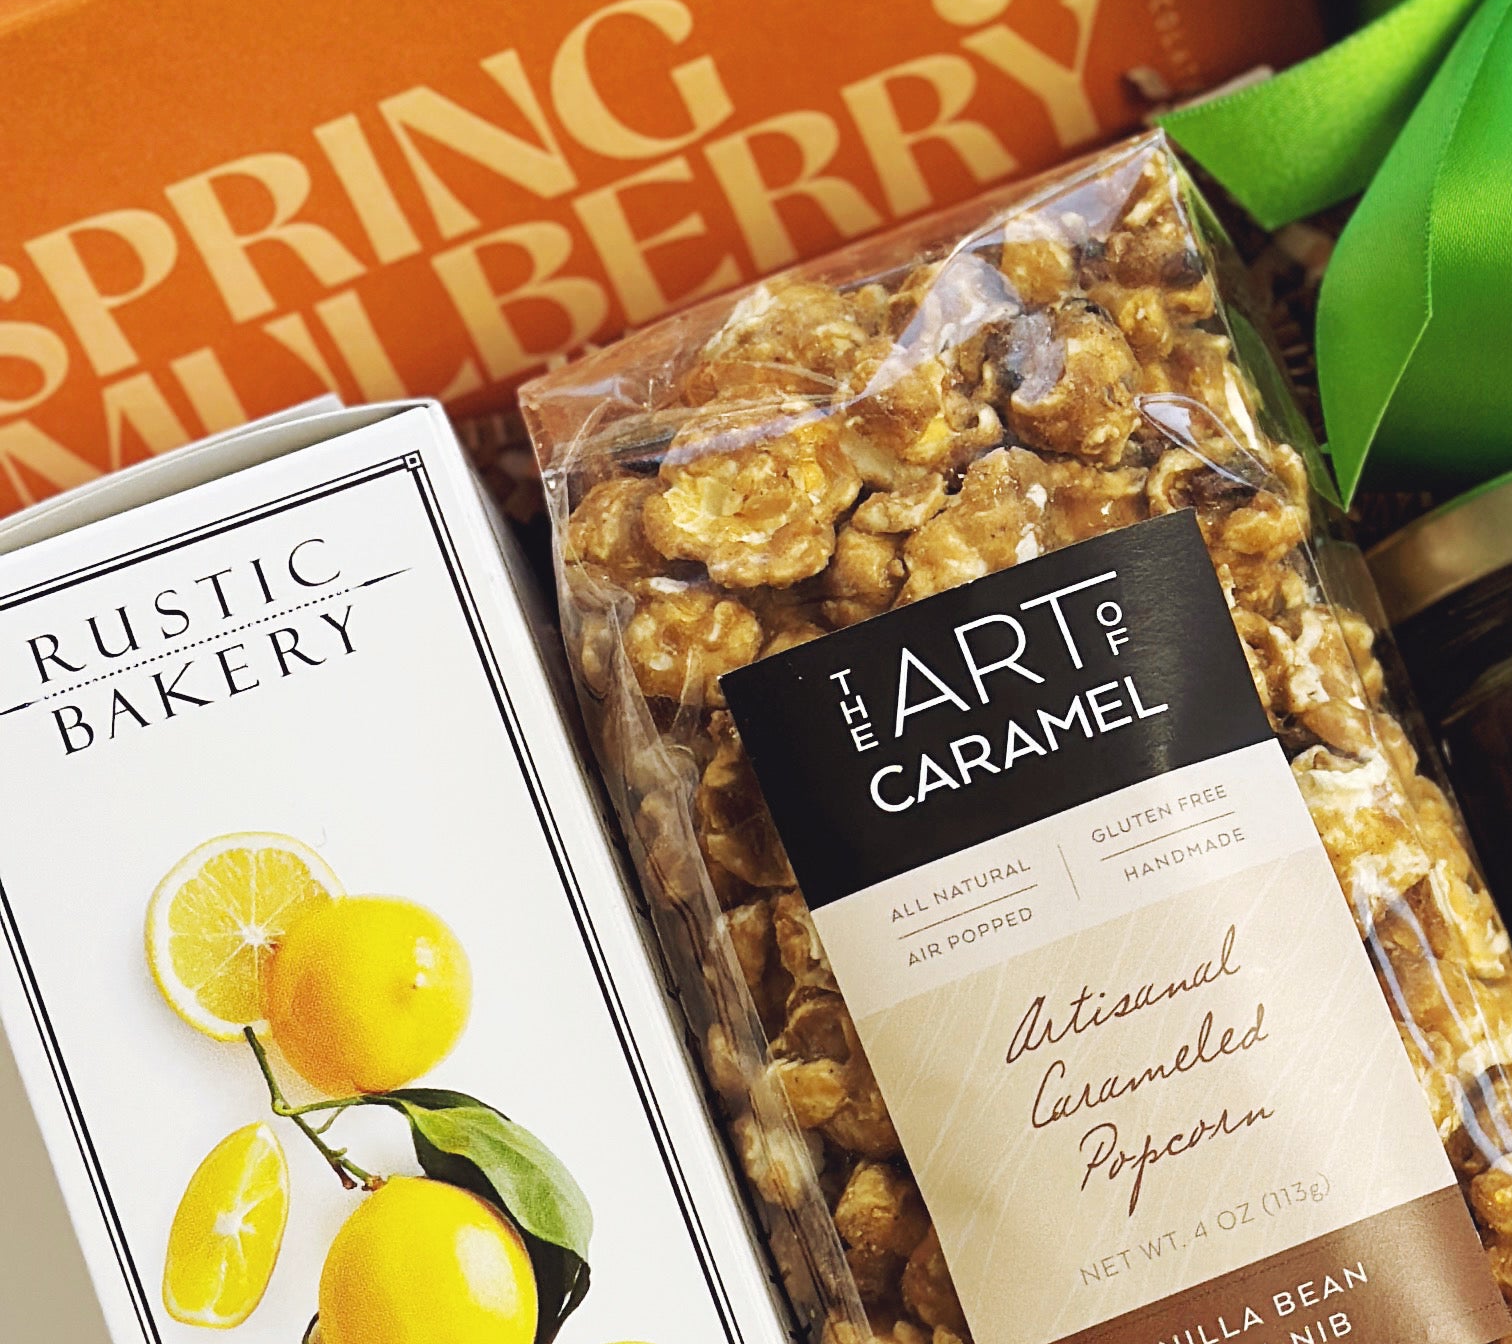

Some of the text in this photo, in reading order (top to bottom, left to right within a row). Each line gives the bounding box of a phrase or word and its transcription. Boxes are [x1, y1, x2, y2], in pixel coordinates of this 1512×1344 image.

[25, 538, 341, 684] RUSTIC
[828, 569, 1131, 753] THE ART OF
[51, 605, 357, 755] BAKERY
[868, 674, 1170, 815] CARAMEL
[1090, 783, 1229, 844] GLUTEN FREE
[1123, 826, 1247, 882] HANDMADE
[890, 857, 1032, 924] ALL NATURAL
[906, 906, 1034, 968] AIR POPPED
[1005, 922, 1240, 1065] Artisanal
[1029, 1002, 1270, 1130] Carameled
[1079, 1104, 1276, 1218] Popcorn
[1080, 1171, 1332, 1287] NET WT. 4 OZ (113g)
[1271, 1261, 1369, 1316] BEAN
